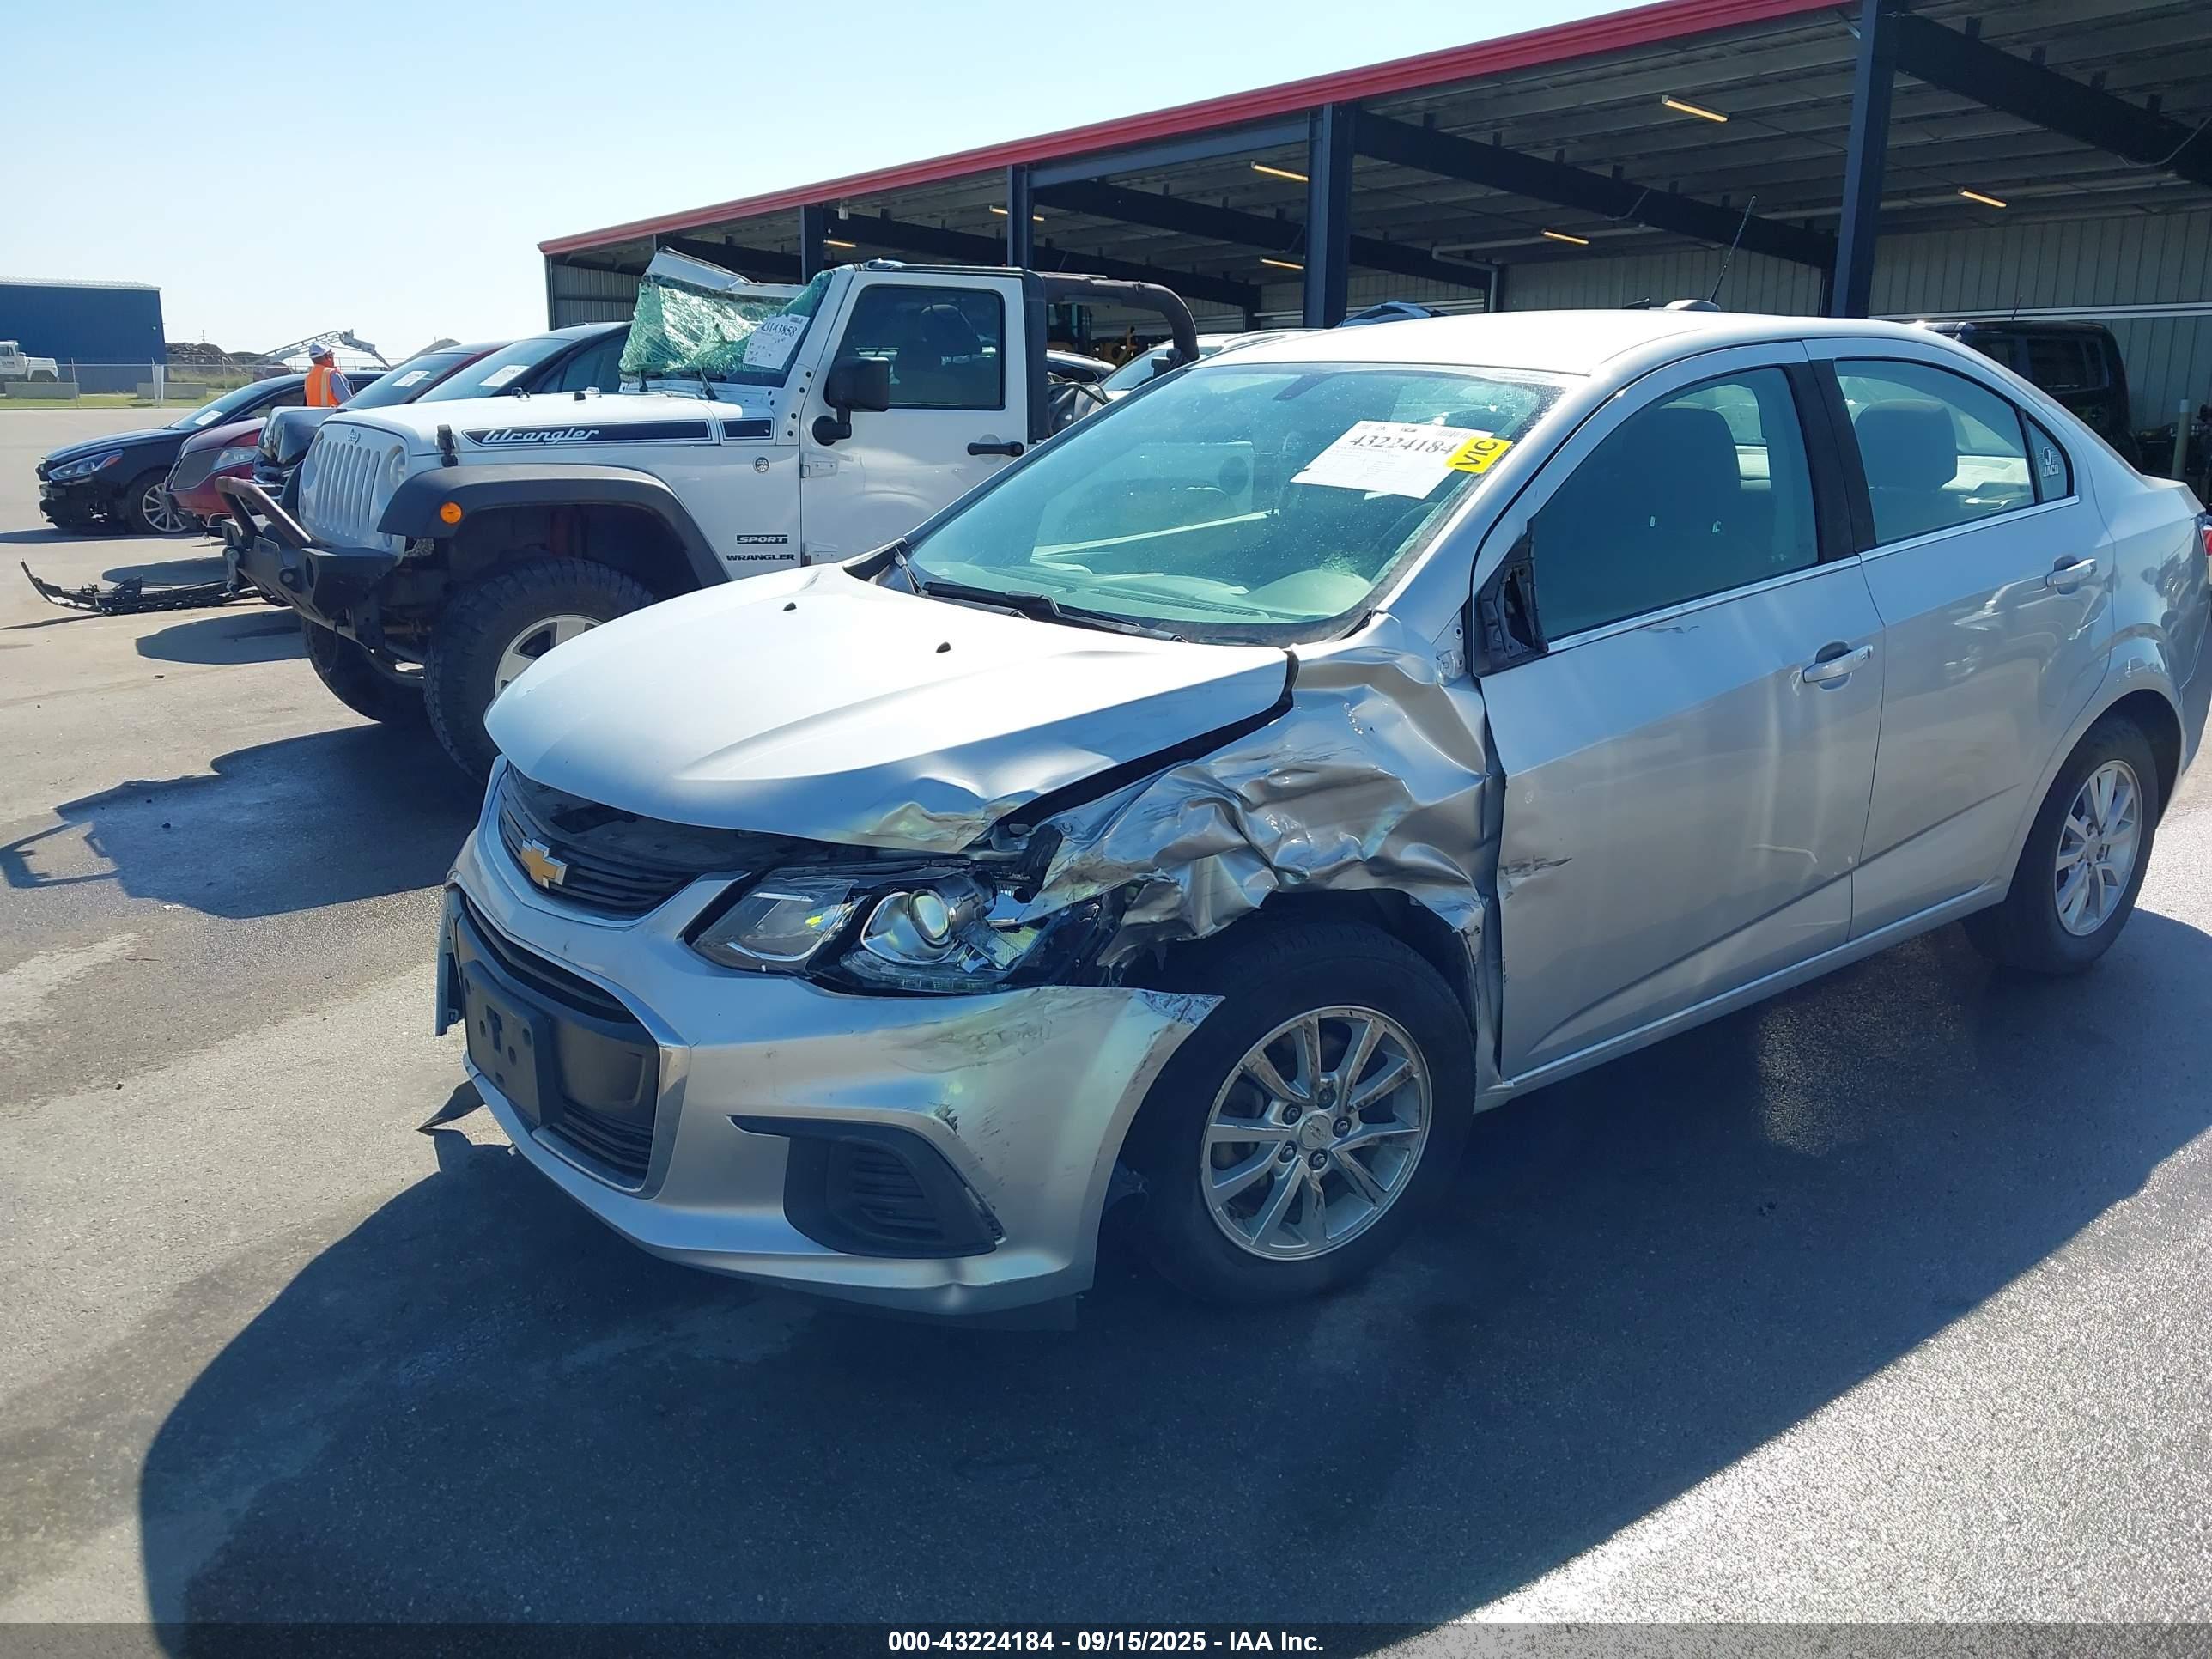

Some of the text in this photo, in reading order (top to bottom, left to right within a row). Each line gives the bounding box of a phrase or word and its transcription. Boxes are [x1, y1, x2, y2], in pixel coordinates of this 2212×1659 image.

[481, 427, 599, 446] Wrangler
[1350, 434, 1458, 454] 43224184
[1455, 440, 1498, 467] VIC
